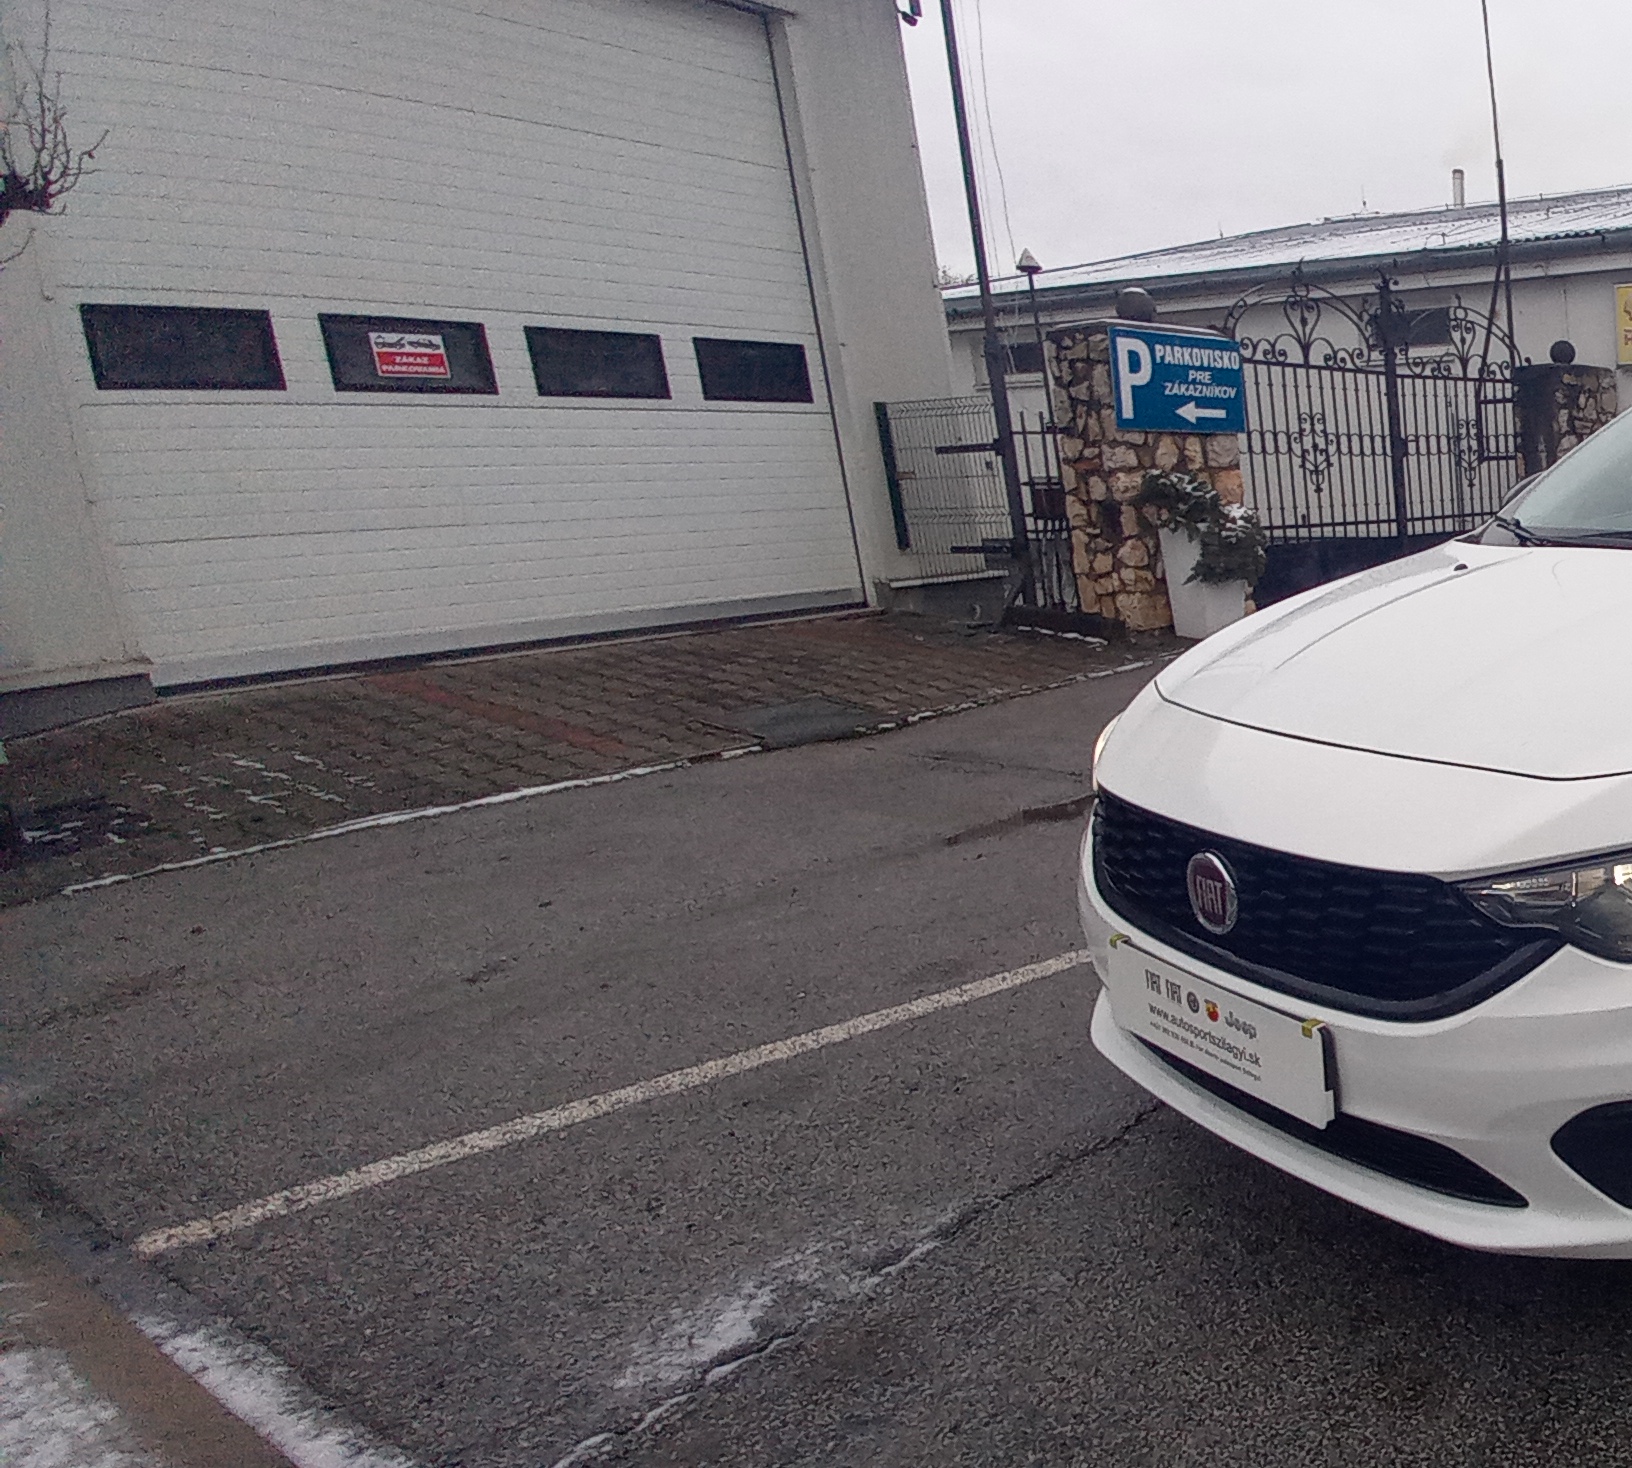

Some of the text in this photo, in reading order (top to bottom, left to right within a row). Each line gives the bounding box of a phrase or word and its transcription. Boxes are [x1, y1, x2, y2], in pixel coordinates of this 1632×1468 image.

[1154, 343, 1240, 370] PARKOVISKO
[1115, 336, 1152, 420] P
[1164, 380, 1238, 399] ZÁKAZNÍKOV
[1188, 370, 1213, 384] PRE
[1195, 874, 1223, 916] FIAT
[1224, 1010, 1258, 1040] Jeep
